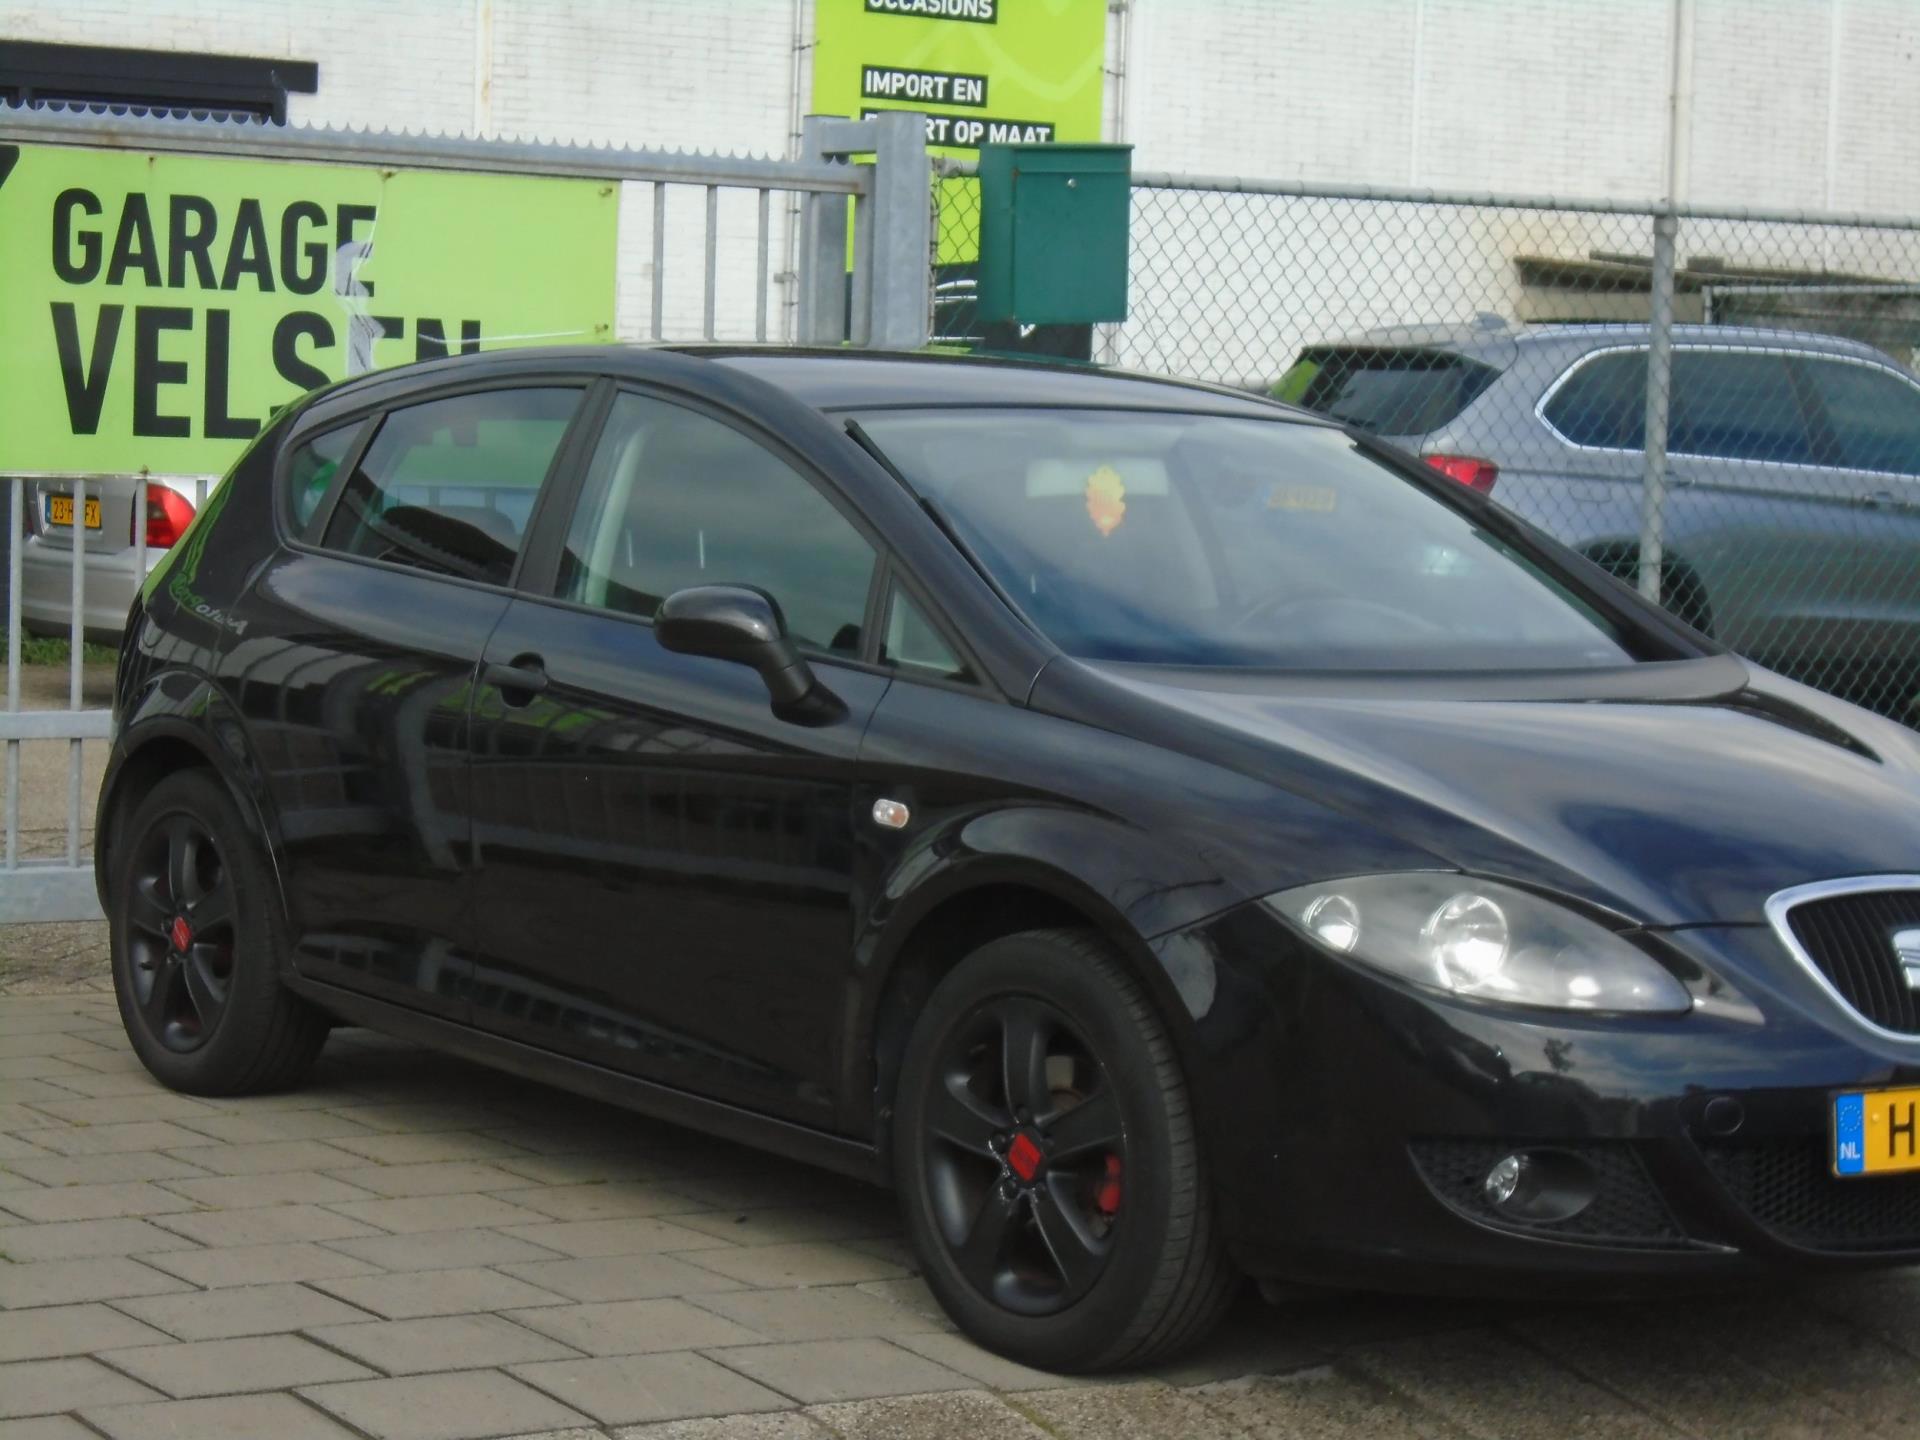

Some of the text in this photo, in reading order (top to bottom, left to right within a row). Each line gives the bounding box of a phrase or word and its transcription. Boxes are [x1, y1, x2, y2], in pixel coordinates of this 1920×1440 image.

[865, 70, 982, 102] IMPORT EN
[954, 120, 984, 143] OP
[989, 123, 1050, 143] MAAT
[50, 302, 481, 439] VELS
[1840, 1141, 1861, 1160] NL
